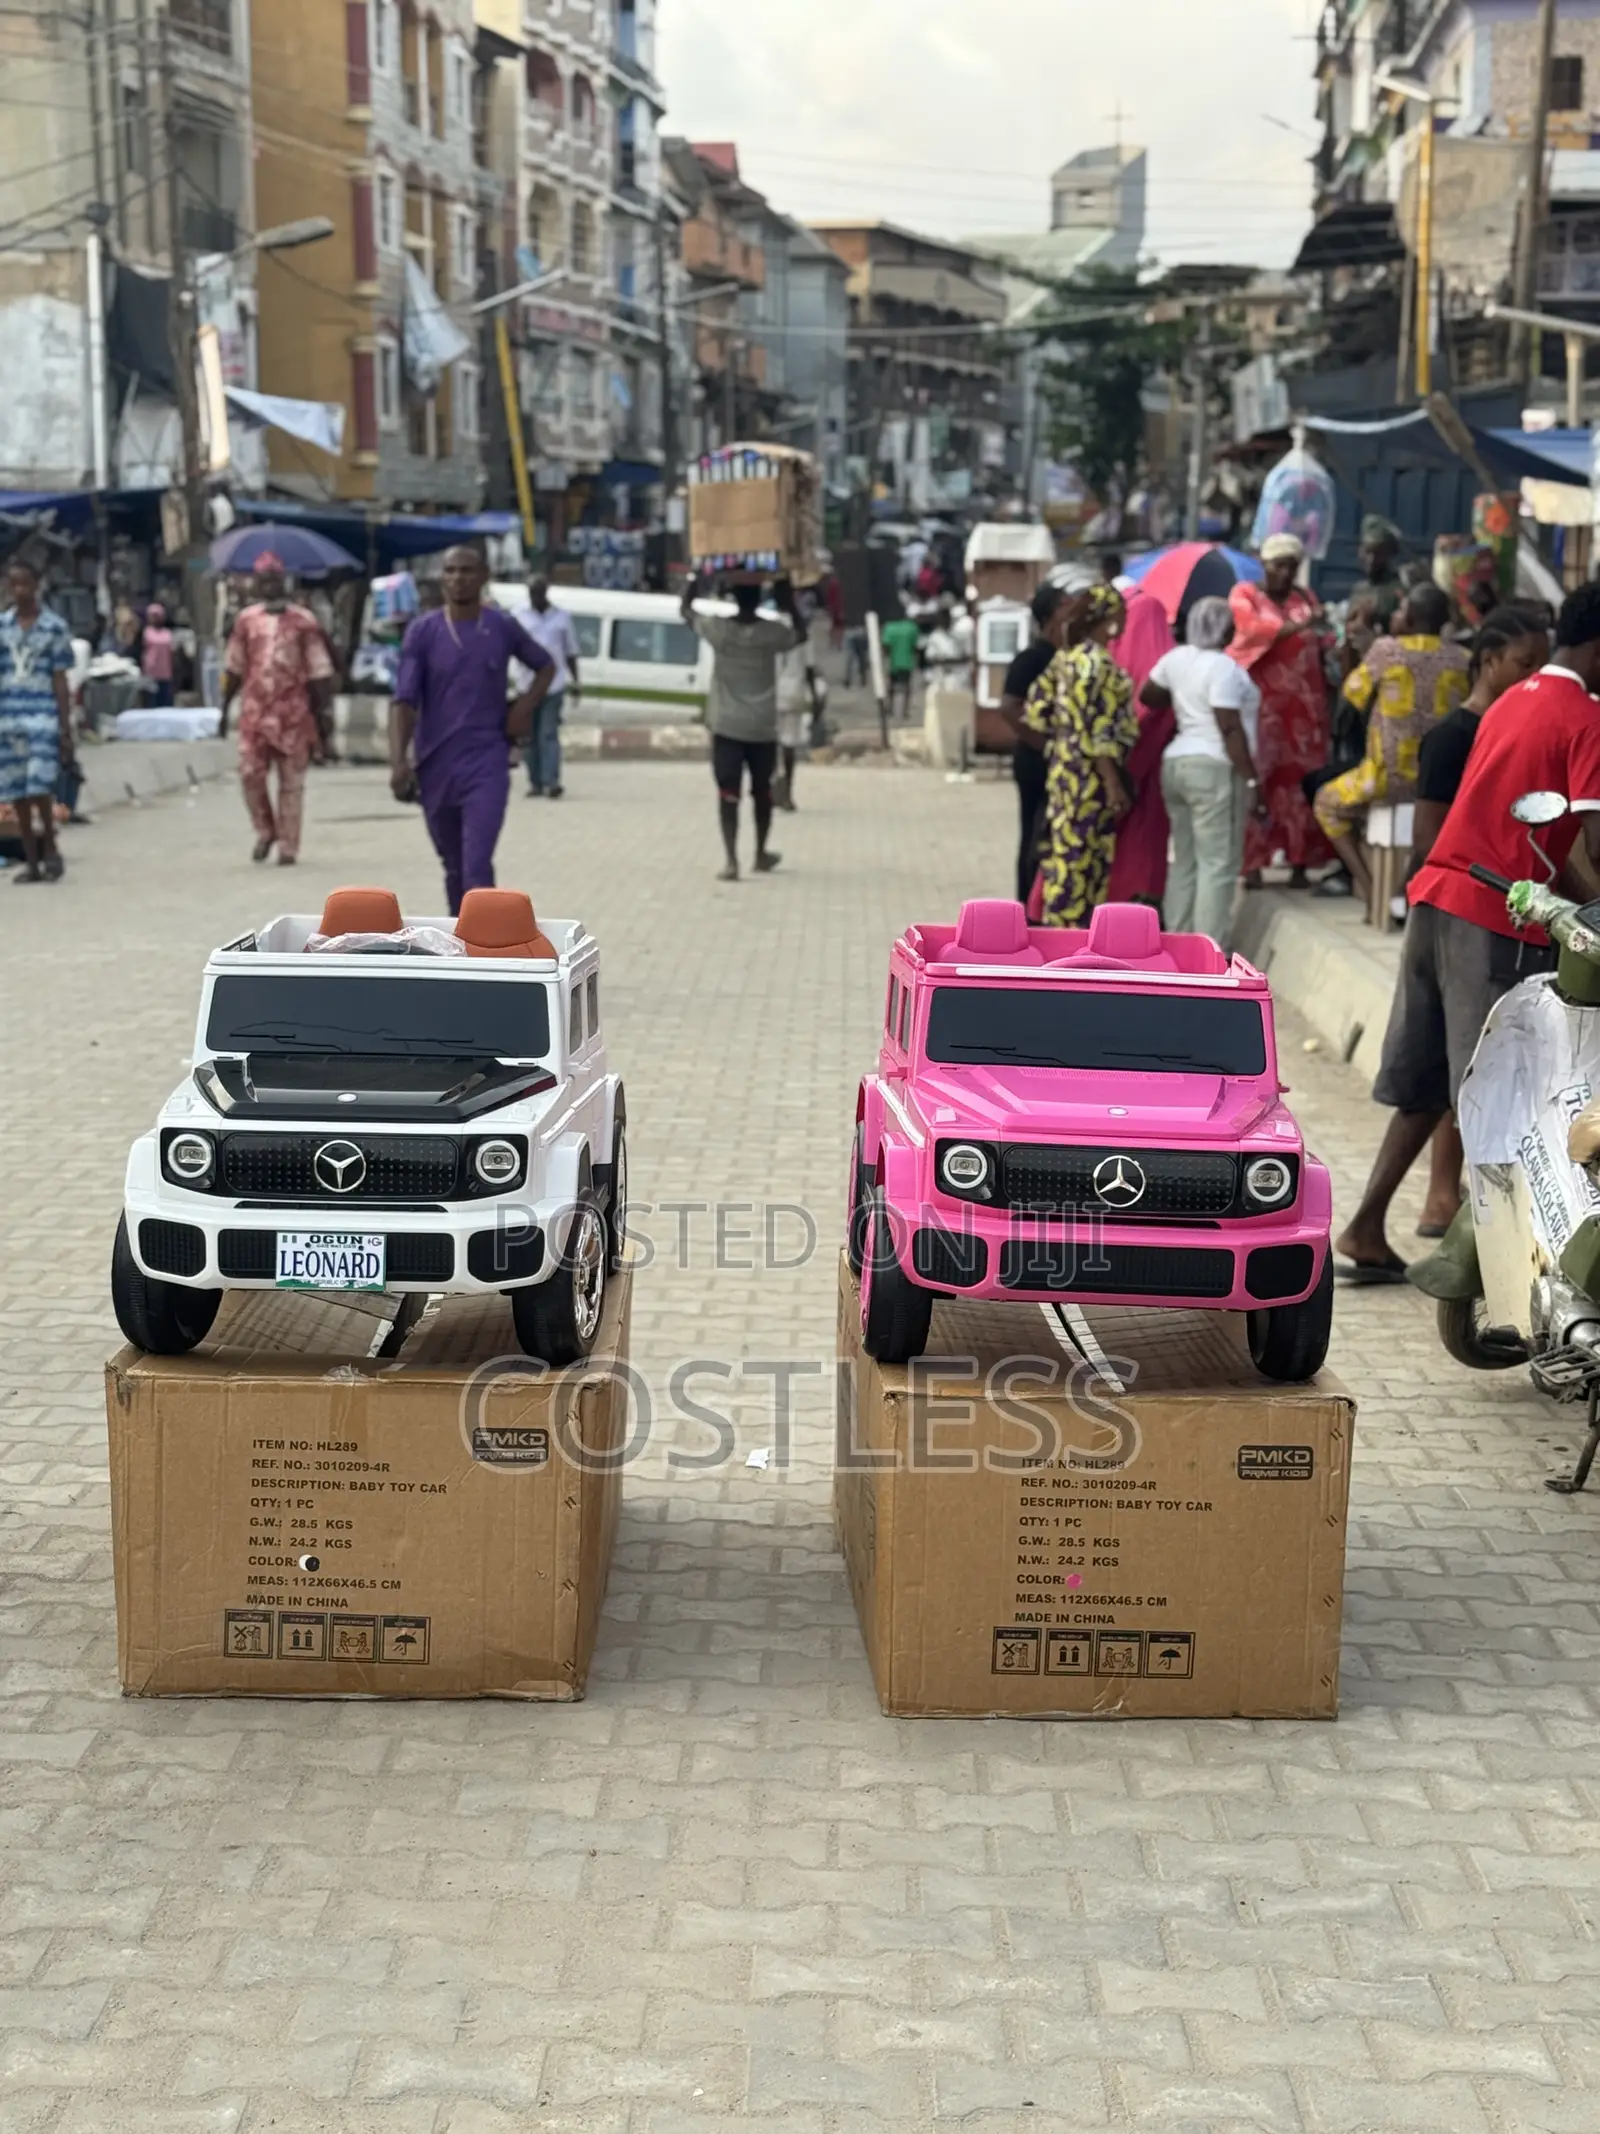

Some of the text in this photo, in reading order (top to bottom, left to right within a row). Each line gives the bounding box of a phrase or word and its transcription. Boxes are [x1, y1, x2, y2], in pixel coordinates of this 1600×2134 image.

[309, 1234, 363, 1244] OGUN
[280, 1250, 380, 1279] LEONARD
[475, 1431, 546, 1446] PMKD
[253, 1439, 358, 1452] ITEM NO: HL289
[1241, 1449, 1310, 1464] PMKD
[252, 1459, 390, 1473] REF. NO.: 3010209-4R
[1022, 1458, 1125, 1470] ITEM NO: HL289
[1242, 1469, 1309, 1478] PRIME KIDS
[251, 1478, 447, 1494] DESCRIPTION: BABY TOY CAR
[1021, 1477, 1157, 1490] REF. NO.: 3010209-4R
[250, 1498, 314, 1509] QTY: 1 PC
[1020, 1497, 1212, 1512] DESCRIPTION: BABY TOY CAR
[250, 1517, 353, 1530] G.W.: 28.5 KGS
[1019, 1516, 1082, 1528] QTY: 1 PC
[249, 1536, 353, 1549] N.W.: 24.2 KGS
[1018, 1536, 1120, 1548] G.W.: 28.5 KGS
[248, 1556, 298, 1567] COLOR:
[1017, 1555, 1119, 1567] N.W.: 24.2 KGS
[247, 1575, 402, 1590] MEAS: 112X66X46.5 CM
[1016, 1574, 1065, 1585] COLOR:
[246, 1595, 349, 1608] MADE IN CHINA
[1015, 1593, 1168, 1607] MEAS: 112X66X46.5 CM
[1015, 1612, 1115, 1624] MADE IN CHINA
